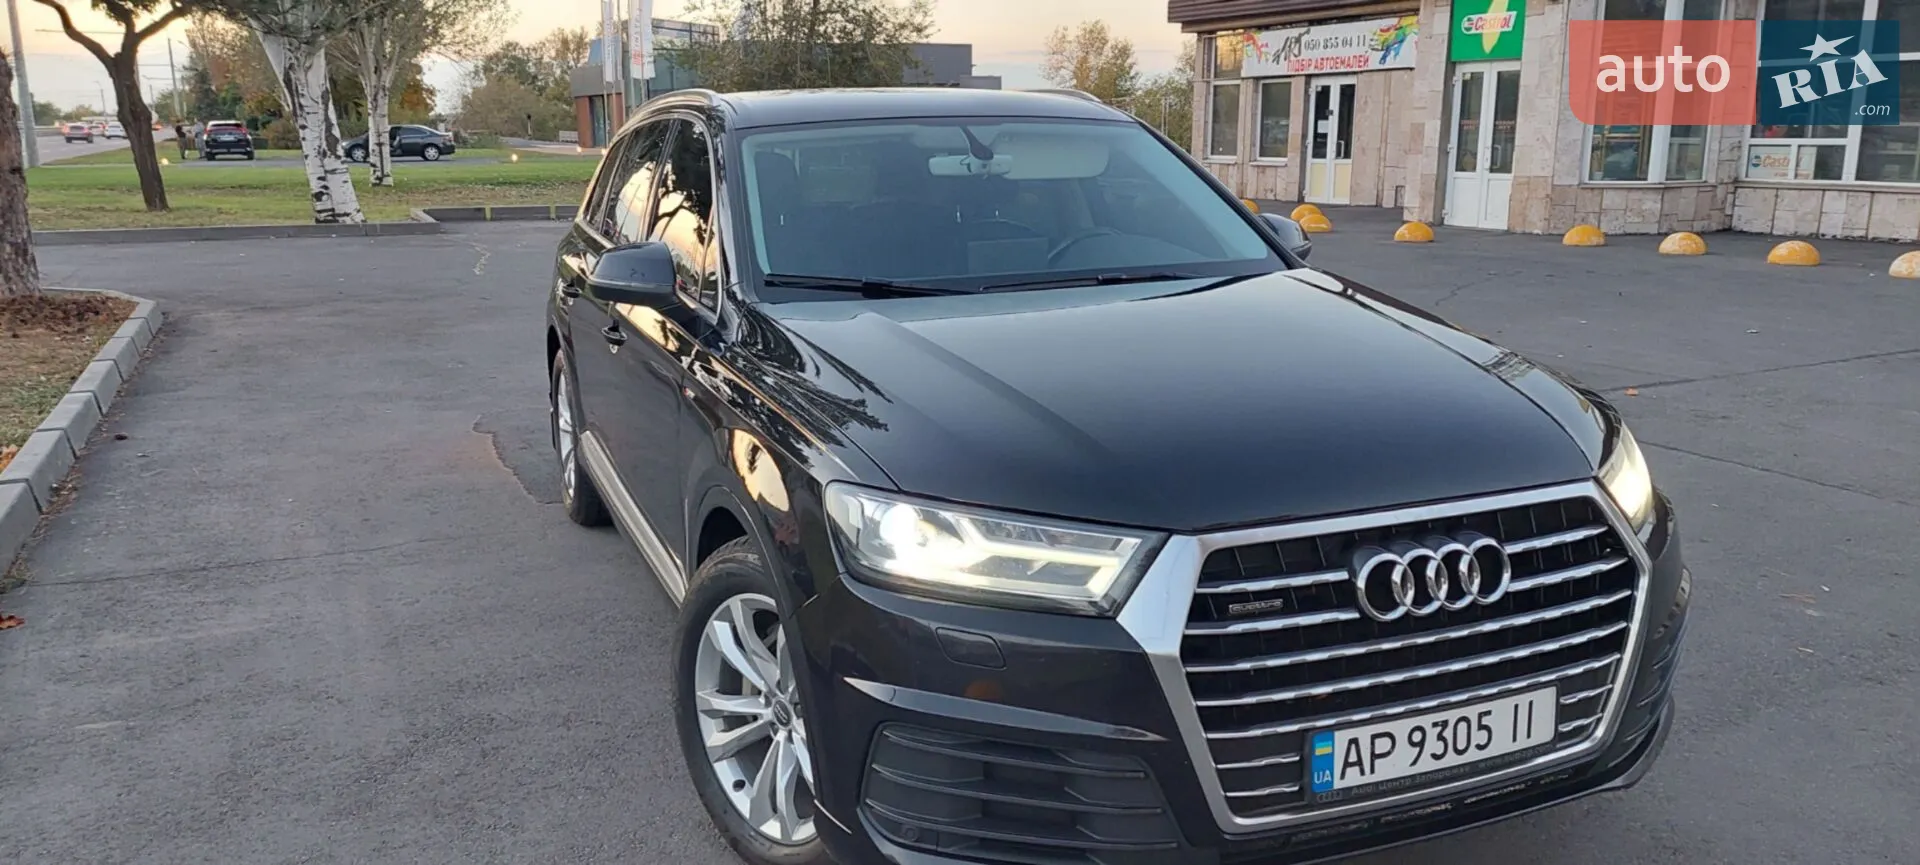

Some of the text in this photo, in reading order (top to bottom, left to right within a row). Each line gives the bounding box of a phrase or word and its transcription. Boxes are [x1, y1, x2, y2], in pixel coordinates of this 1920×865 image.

[1304, 39, 1320, 51] 050
[1323, 36, 1339, 49] 855
[1356, 34, 1366, 47] 11
[1286, 53, 1369, 73] ПІДБІР АВТОЕМАЛЕЙ
[1340, 731, 1397, 780] AP
[1407, 709, 1493, 767] 9305
[1314, 769, 1332, 784] UA
